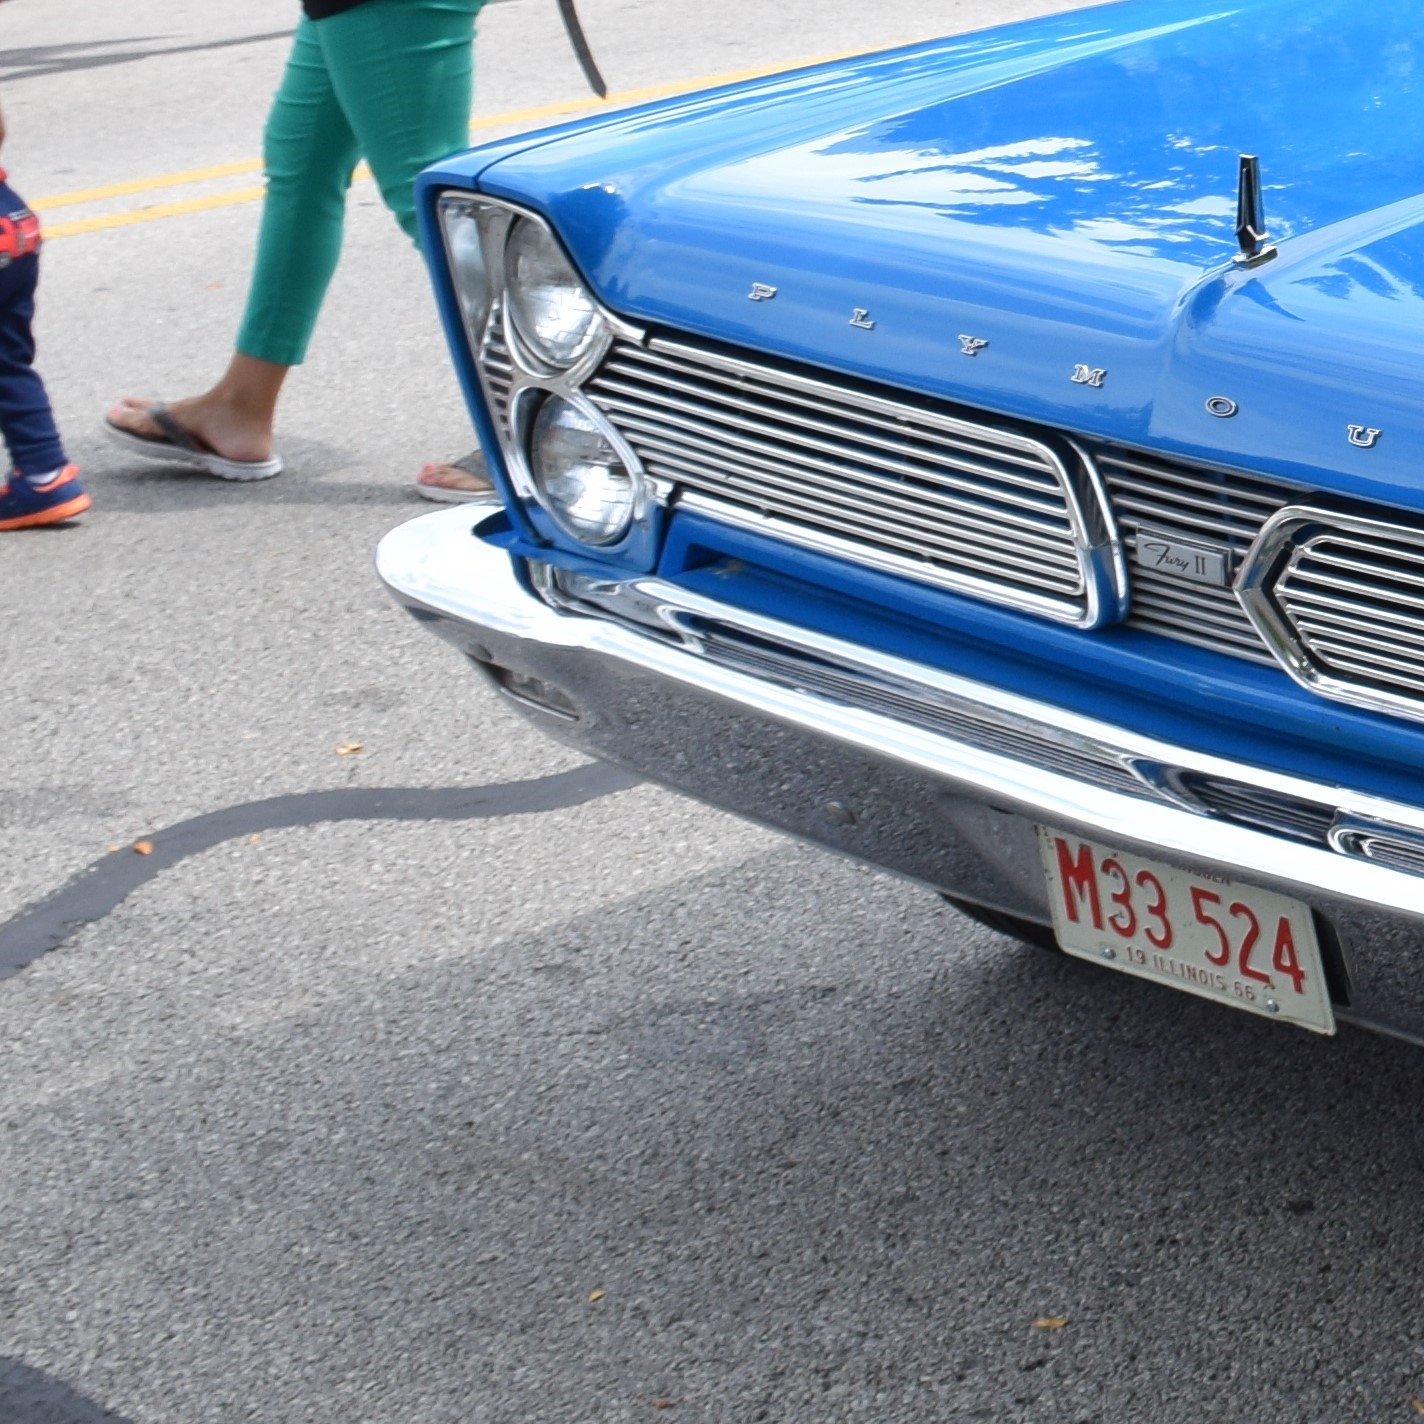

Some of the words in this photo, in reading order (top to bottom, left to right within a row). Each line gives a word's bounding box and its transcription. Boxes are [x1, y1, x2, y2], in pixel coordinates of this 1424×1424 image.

[1143, 542, 1190, 572] Fury
[1194, 555, 1206, 575] II
[1054, 836, 1174, 951] M33
[1189, 885, 1306, 996] 524
[1126, 945, 1147, 966] 19
[1153, 954, 1228, 992] ILLINOIS
[1234, 981, 1257, 1002] 66
